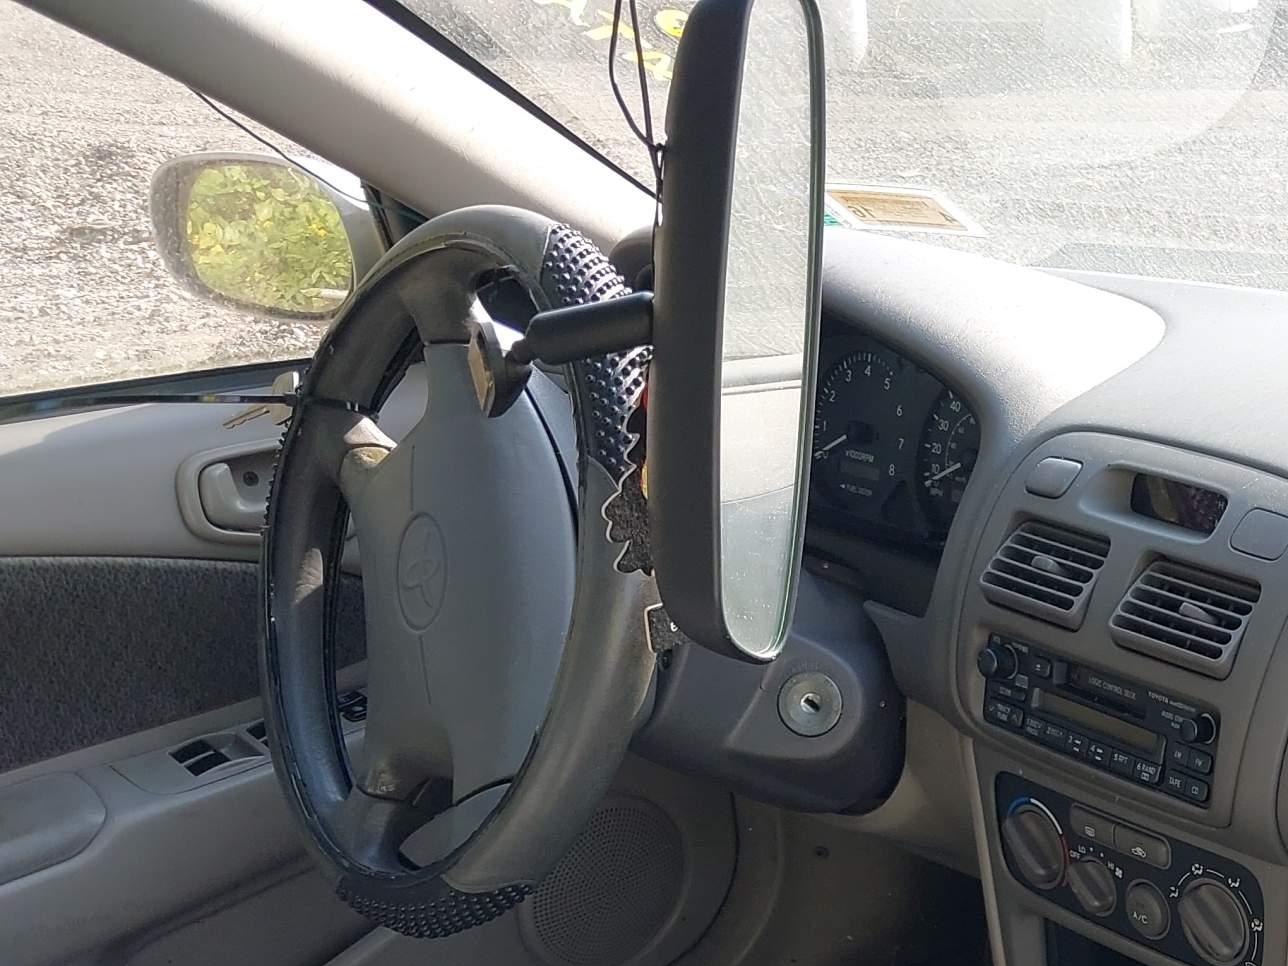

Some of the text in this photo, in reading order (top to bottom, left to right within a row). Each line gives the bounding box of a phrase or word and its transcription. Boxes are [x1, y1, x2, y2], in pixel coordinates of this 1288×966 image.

[845, 369, 852, 382] 3
[864, 365, 871, 377] 4
[884, 377, 891, 390] 5
[829, 390, 836, 402] 2
[896, 404, 903, 417] 6
[950, 401, 961, 412] 40
[938, 419, 949, 431] 30
[898, 438, 904, 450] 7
[931, 442, 942, 454] 20
[888, 463, 895, 476] 8
[931, 463, 940, 474] 10
[1148, 691, 1169, 704] TOYOTA
[1169, 776, 1182, 789] TAPE
[1132, 911, 1149, 925] A/C
